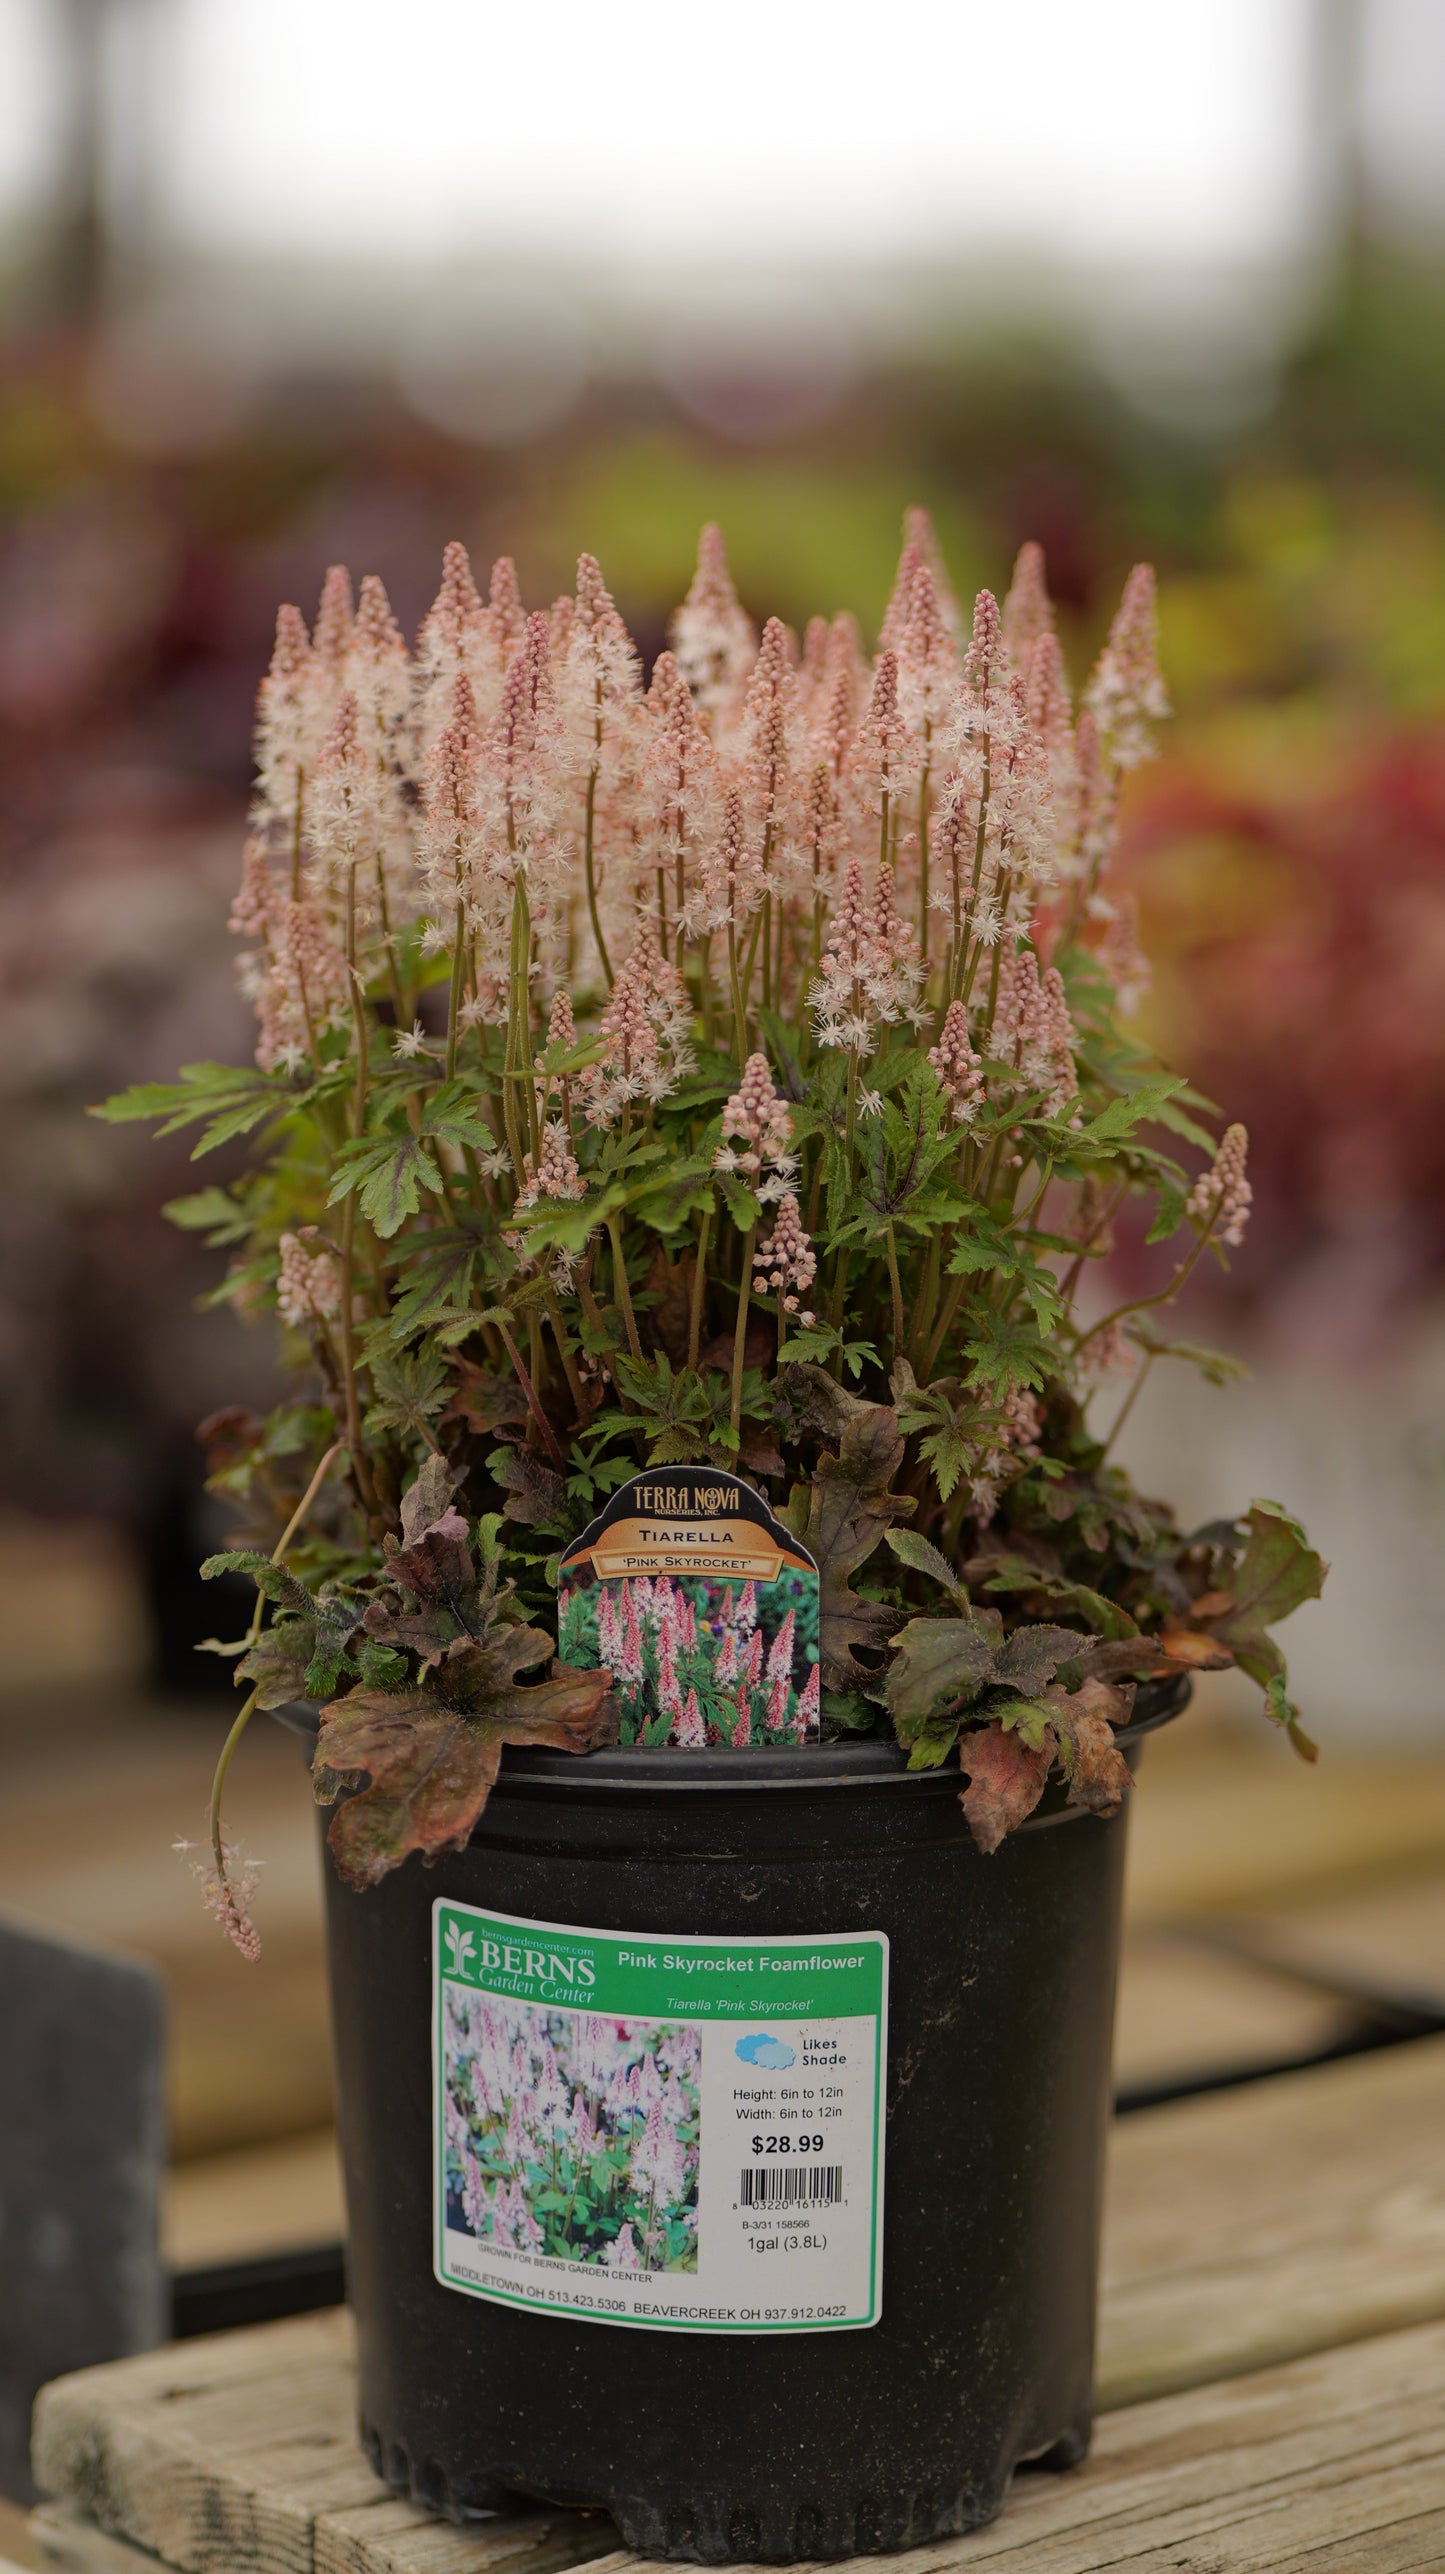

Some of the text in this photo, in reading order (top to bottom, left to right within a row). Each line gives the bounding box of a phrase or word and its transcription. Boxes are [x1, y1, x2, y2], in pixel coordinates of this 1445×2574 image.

[633, 1486, 739, 1510] TERRA NOVA
[639, 1530, 734, 1543] TIARELLA
[482, 1928, 594, 1957] bernsgardencenter.com
[480, 1939, 596, 1986] BERNS
[618, 1951, 865, 1973] Pink Skyrocket Foamflower
[479, 1967, 595, 2003] Garden Center
[666, 1997, 813, 2013] Tiarella 'Pink Skyrocket'
[803, 2039, 837, 2050] Likes
[802, 2054, 847, 2066] Shade
[733, 2087, 843, 2102] Height: 6in to 12in
[736, 2106, 842, 2120] Width: 6in to 12in
[751, 2134, 824, 2155] $28.99
[752, 2200, 789, 2210] 03220
[796, 2199, 830, 2209] 16115
[742, 2220, 810, 2230] B-3/31 158566
[748, 2234, 827, 2253] 1gal (3.8L)
[477, 2243, 652, 2283] GROWN FOR BERNS GARDEN CENTER
[451, 2263, 847, 2320] MIDDLETOWN OH 513.423.5306 BEAVERCREEK OH 937.912.0422
